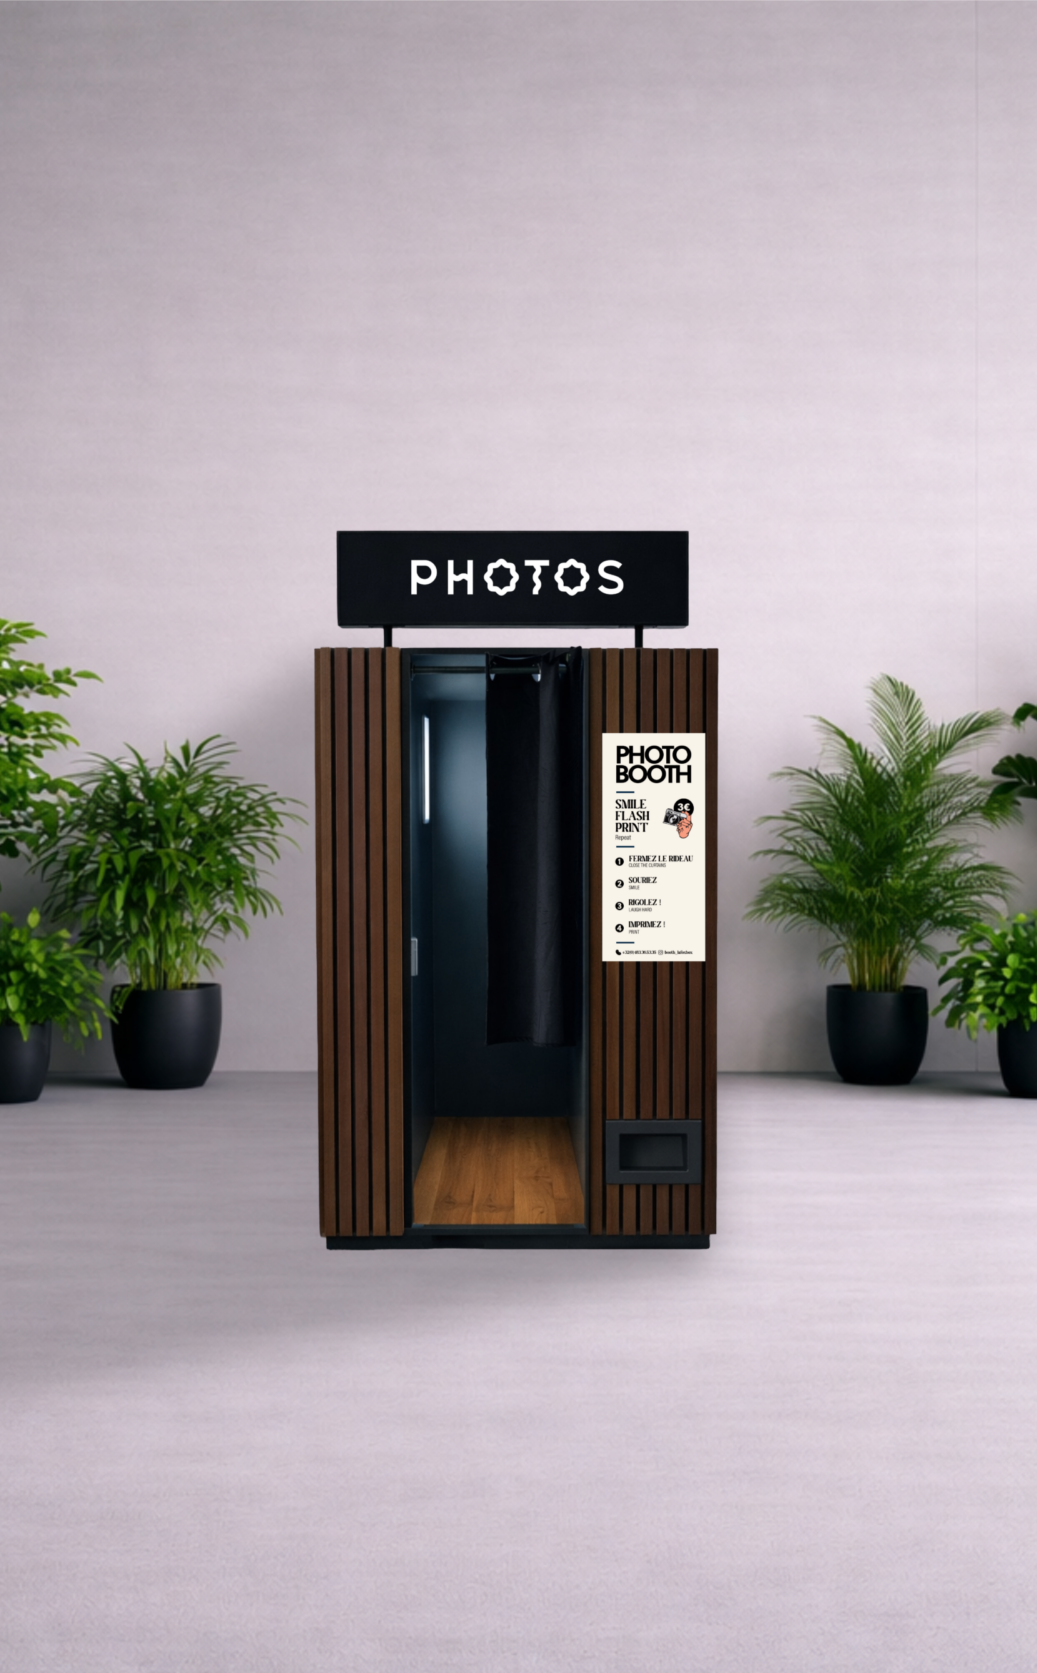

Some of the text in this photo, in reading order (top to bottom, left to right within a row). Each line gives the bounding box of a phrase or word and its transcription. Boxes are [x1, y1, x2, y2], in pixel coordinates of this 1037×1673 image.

[411, 558, 624, 596] PHOTOS
[616, 745, 692, 764] PHOTO
[616, 765, 692, 784] BOOTH
[615, 799, 647, 809] SMILE
[677, 803, 690, 811] 3€
[615, 811, 650, 821] FLASH
[615, 822, 649, 832] PRINT
